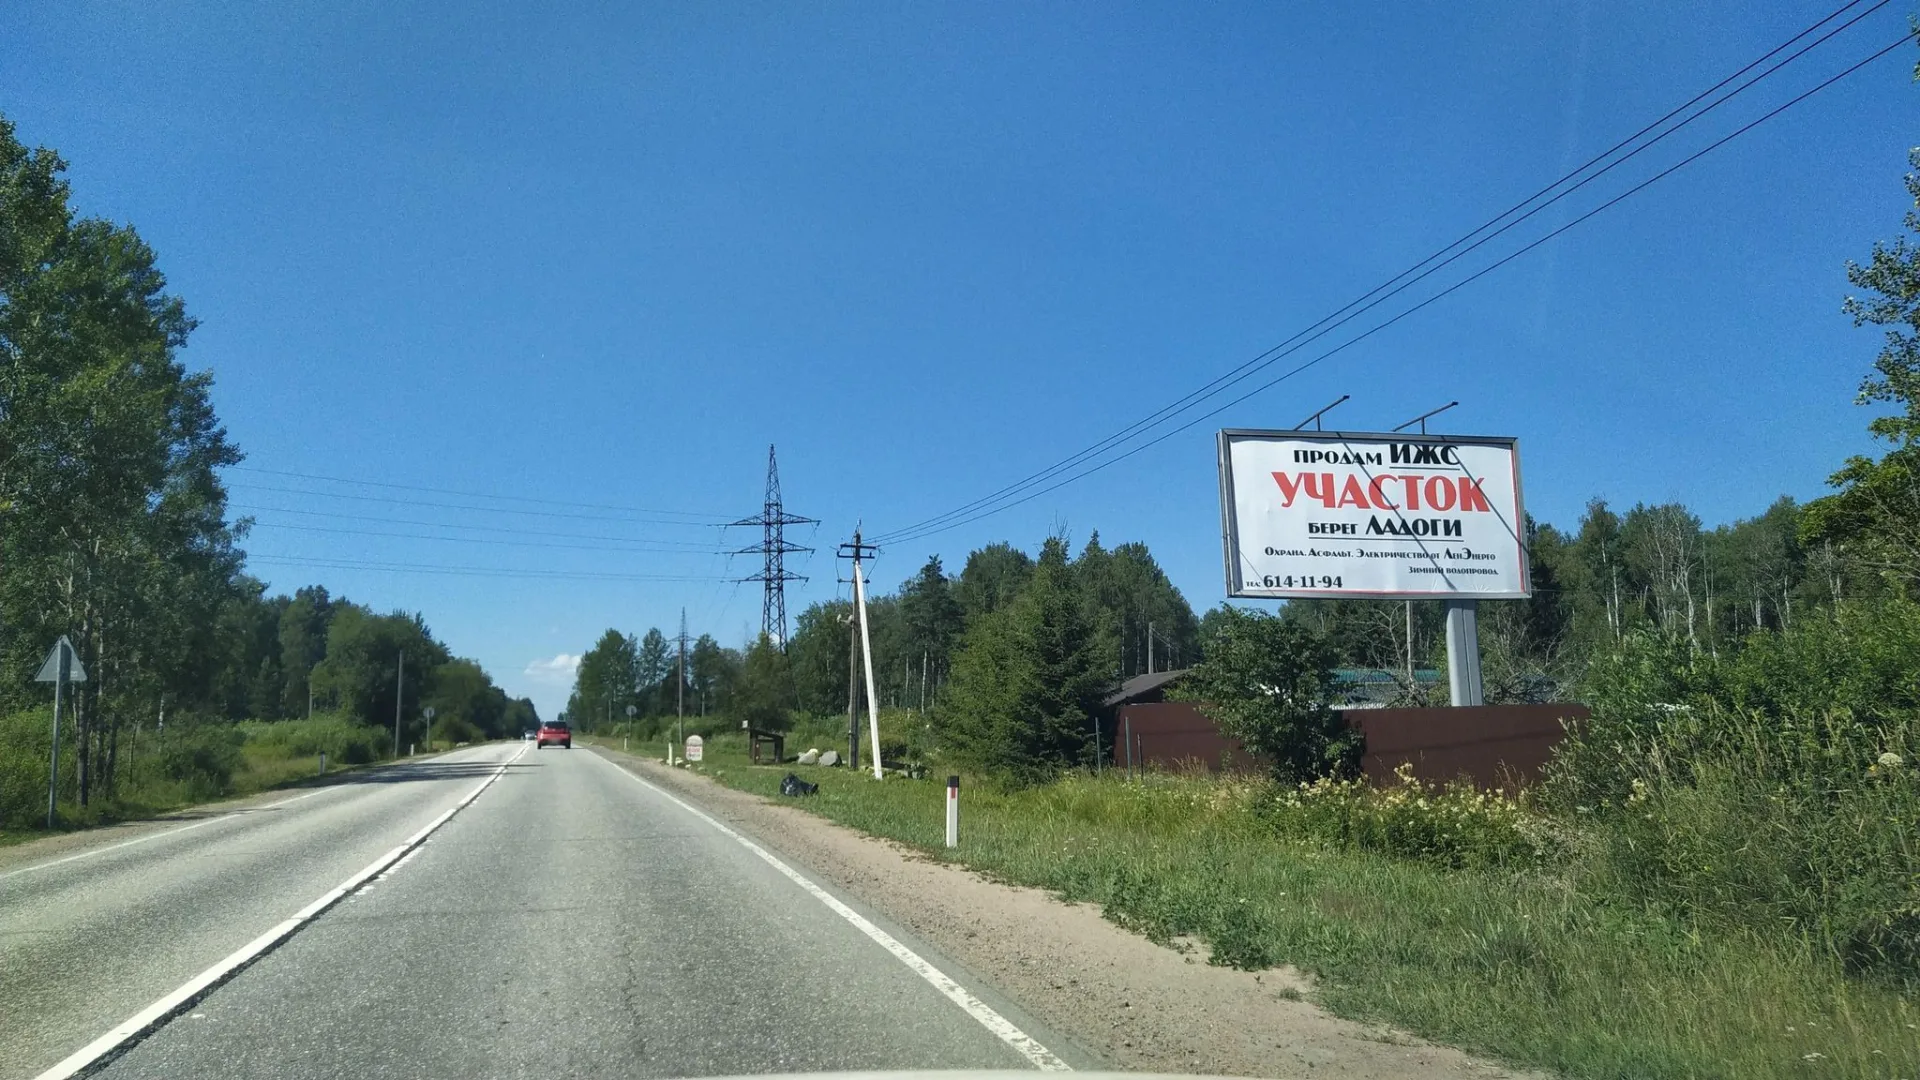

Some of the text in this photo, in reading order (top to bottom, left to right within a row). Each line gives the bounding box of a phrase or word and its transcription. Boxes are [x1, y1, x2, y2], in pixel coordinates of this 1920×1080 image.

[1293, 443, 1460, 466] ПРОДАМ ИЖС
[1271, 471, 1490, 513] УЧАСТОК
[1308, 514, 1462, 537] БЕРЕГ ЛАДОГИ
[1263, 574, 1343, 588] 614-11-94
